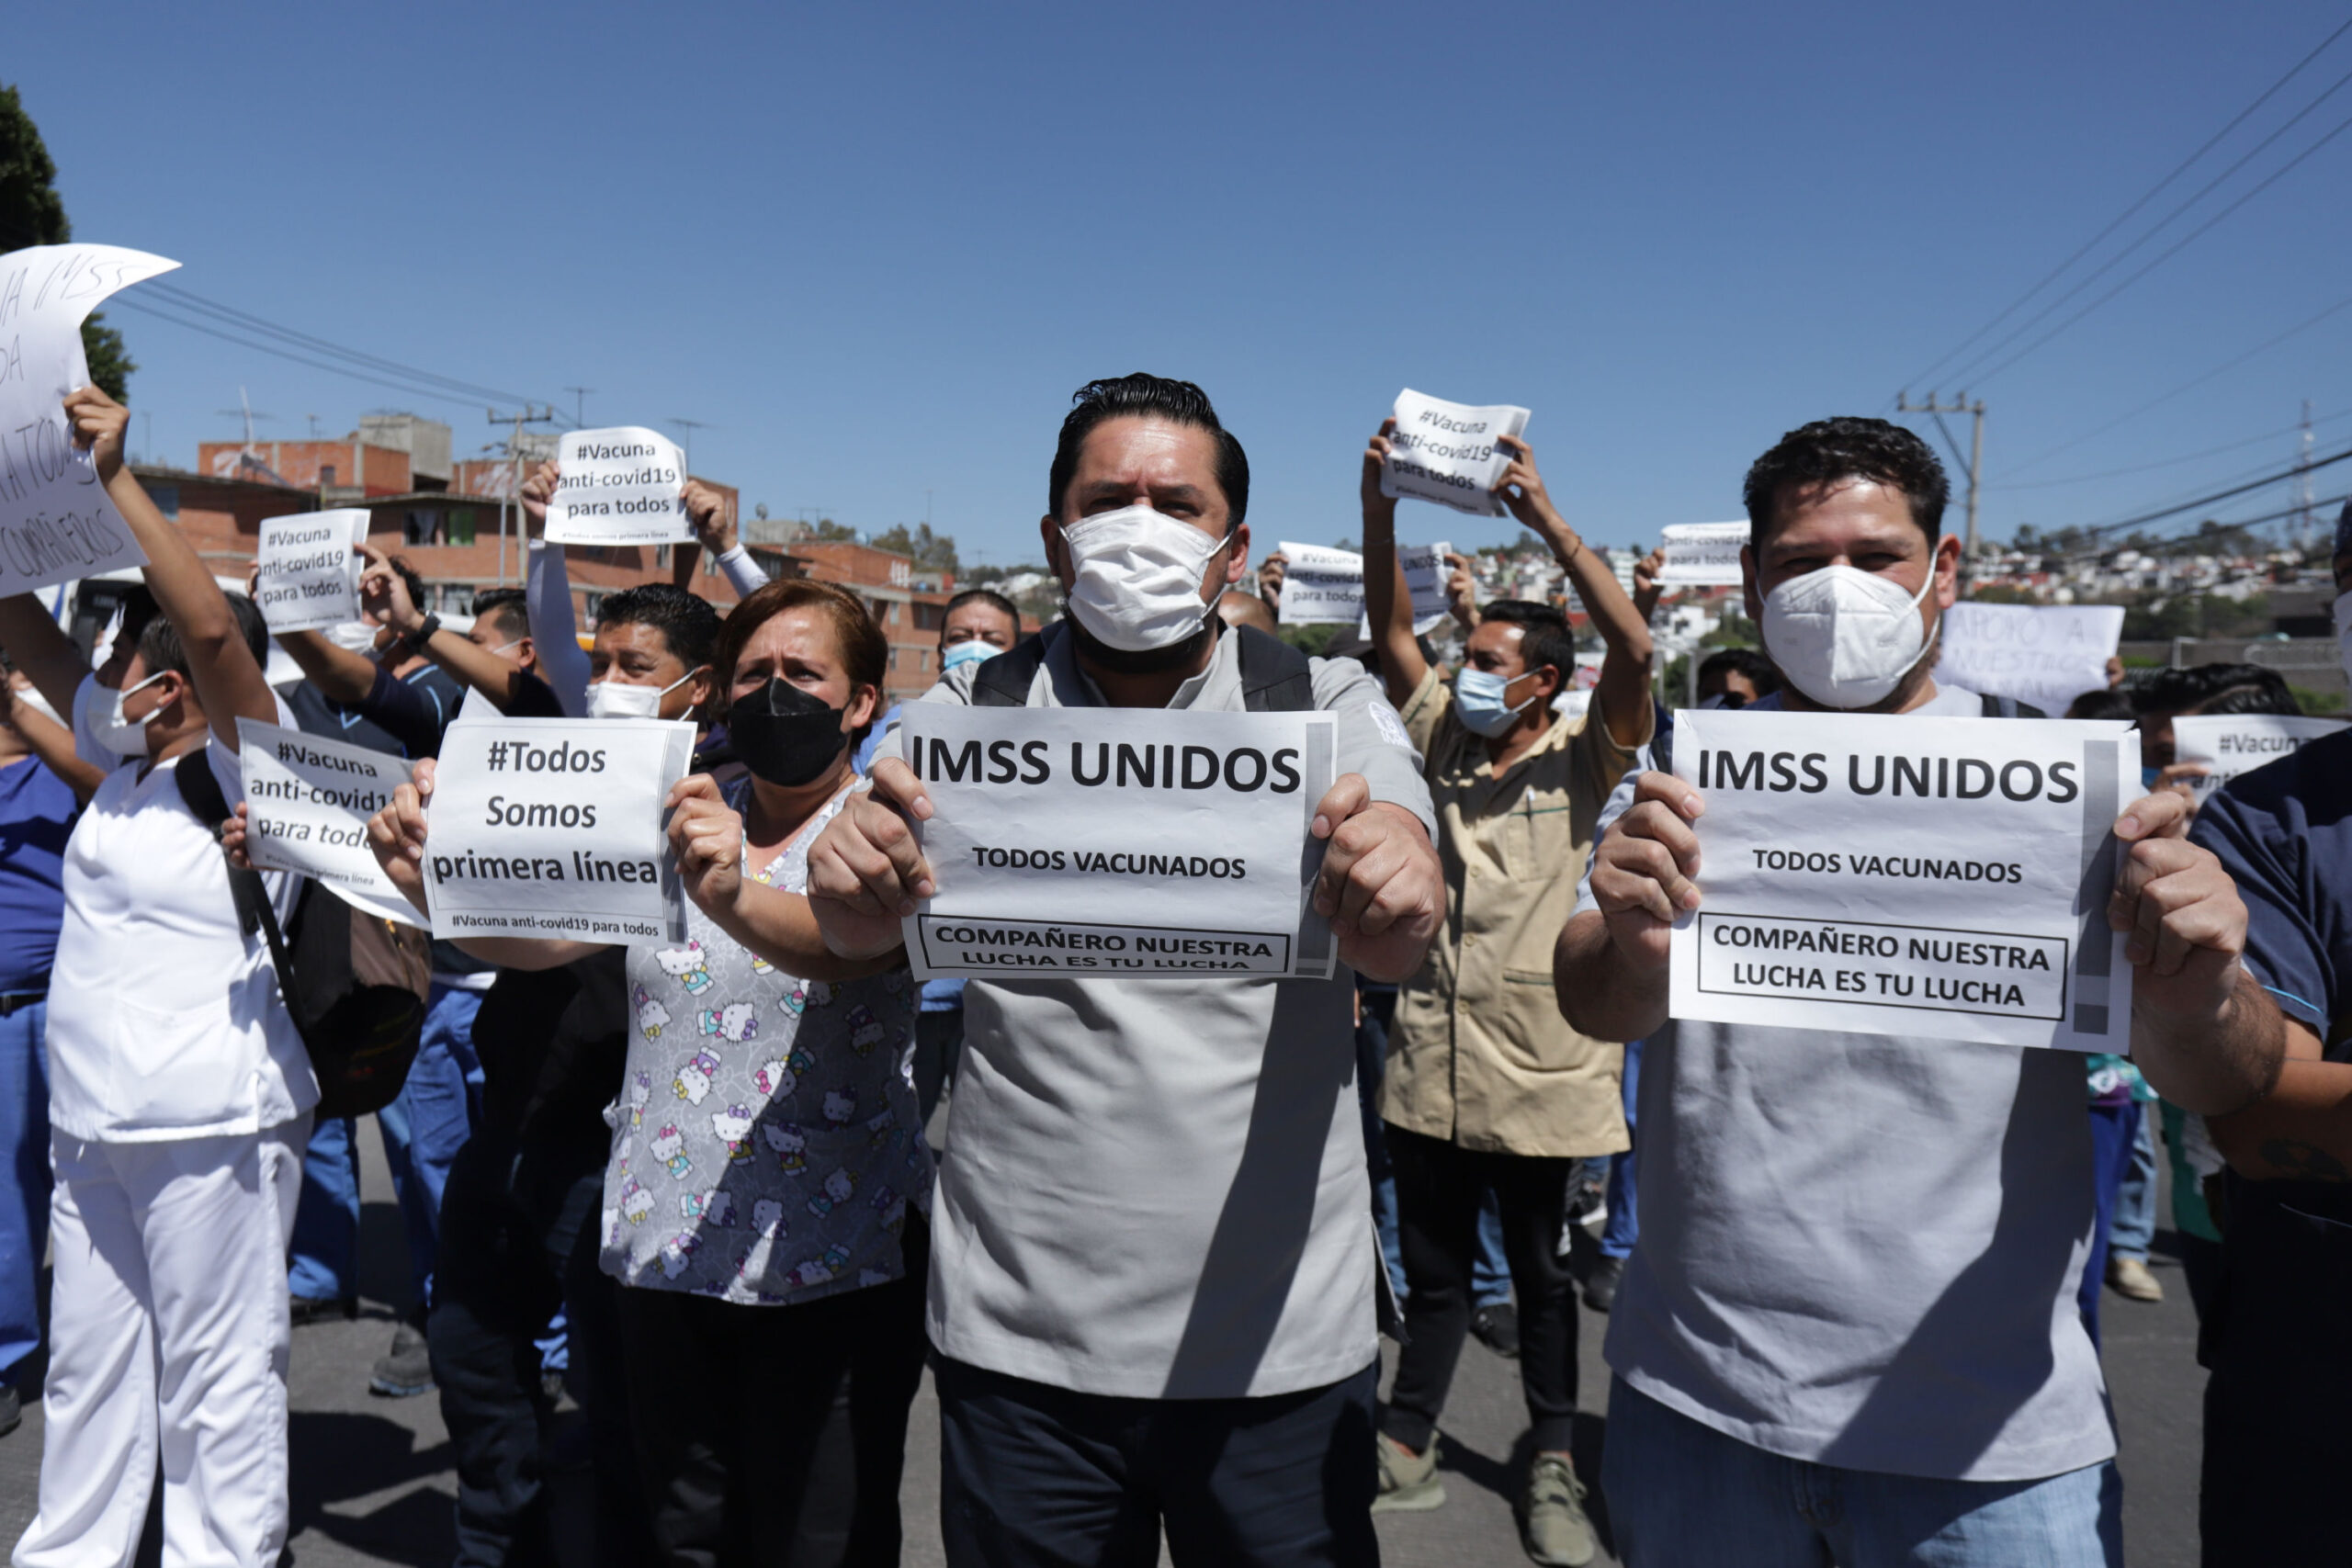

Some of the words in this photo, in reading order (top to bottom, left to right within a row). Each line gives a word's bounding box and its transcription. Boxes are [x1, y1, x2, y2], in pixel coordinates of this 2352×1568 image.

[1419, 410, 1487, 434] #Vacuna
[577, 444, 656, 461] #Vacuna
[1393, 430, 1493, 462] anti-covid19
[559, 467, 676, 490] anti-covid19
[1394, 460, 1426, 479] para
[1430, 466, 1476, 491] todos
[568, 502, 610, 520] para
[615, 496, 670, 515] todos
[268, 528, 332, 547] #Vacuna
[1301, 552, 1358, 565] #Vacuna
[1705, 551, 1739, 565] todo
[1288, 570, 1363, 583] anti-covid1
[264, 585, 298, 607] para
[301, 581, 342, 599] todos
[1293, 591, 1321, 604] para
[277, 742, 378, 778] #Vacuna
[488, 740, 606, 773] #Todos
[912, 735, 1051, 785] IMSS
[1071, 741, 1301, 795] UNIDOS
[1698, 749, 1828, 794] IMSS
[1848, 753, 2079, 804] UNIDOS
[251, 779, 395, 813] anti-covid1
[485, 795, 596, 829] Somos
[258, 818, 311, 840] para
[319, 824, 372, 851] tod
[433, 849, 564, 884] primera
[573, 851, 658, 884] línea
[972, 846, 1066, 872] TODOS
[1073, 851, 1246, 880] VACUNADOS
[1752, 849, 1841, 874] TODOS
[1849, 854, 2023, 884] VACUNADOS
[452, 914, 508, 928] #Vacuna
[511, 916, 589, 931] anti-covid19
[593, 921, 620, 934] para
[623, 922, 659, 937] todos
[935, 926, 1127, 953] COMPAÑERO
[1136, 937, 1273, 958] NUESTRA
[1713, 924, 1899, 958] COMPAÑERO
[1908, 939, 2051, 972] NUESTRA
[962, 951, 1058, 967] LUCHA
[1067, 955, 1098, 967] ES
[1110, 957, 1144, 969] TU
[1154, 958, 1250, 970] LUCHA
[1733, 962, 1826, 991] LUCHA
[1836, 969, 1867, 994] ES
[1875, 972, 1915, 997] TU
[1923, 976, 2026, 1007] LUCHA
